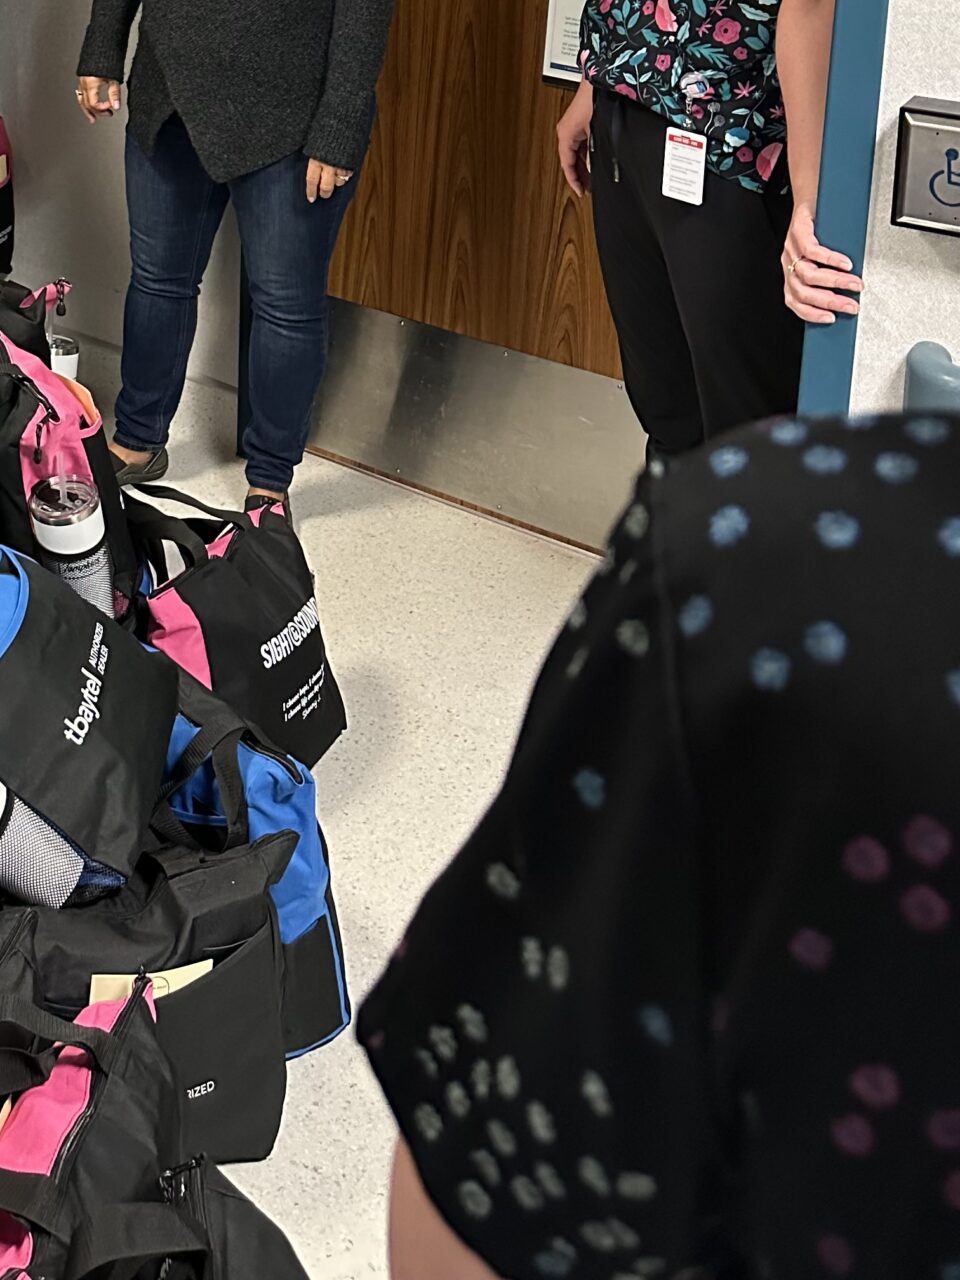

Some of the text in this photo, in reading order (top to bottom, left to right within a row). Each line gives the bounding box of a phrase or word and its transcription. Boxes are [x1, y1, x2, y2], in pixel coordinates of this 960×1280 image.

[88, 622, 104, 668] AUTHORIZED
[97, 644, 109, 675] DEALER
[64, 666, 102, 745] tbaytel
